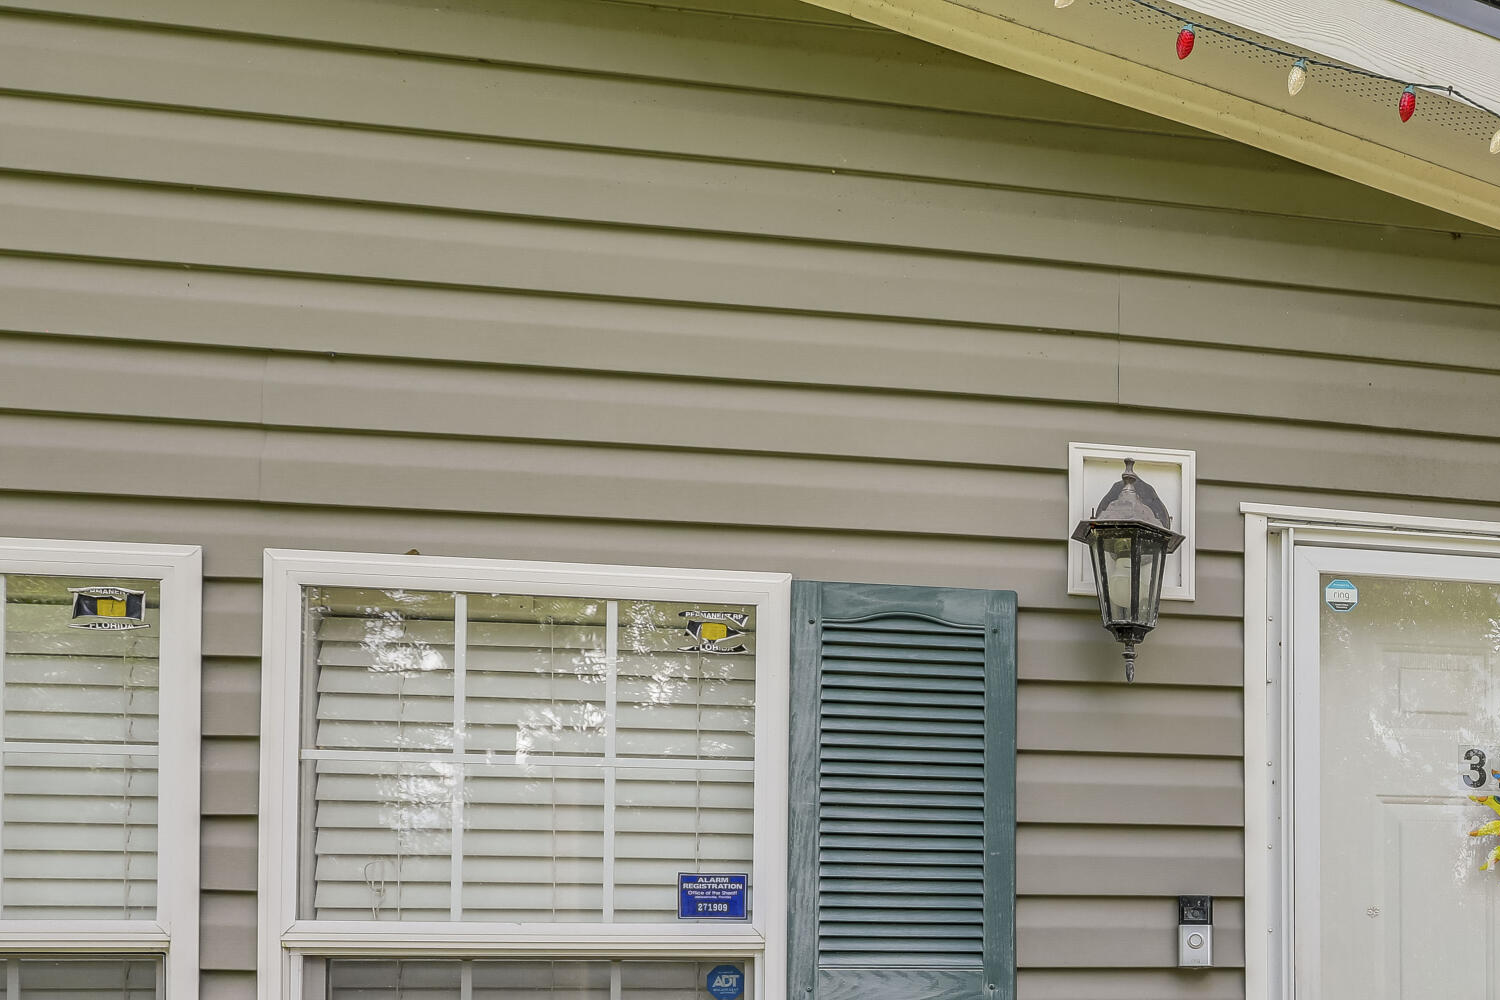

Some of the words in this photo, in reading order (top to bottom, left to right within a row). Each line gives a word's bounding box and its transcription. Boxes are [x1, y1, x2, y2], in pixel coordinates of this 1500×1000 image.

[1333, 591, 1350, 600] ring
[89, 622, 135, 630] FLORIDA
[697, 903, 728, 912] 271909
[711, 974, 740, 988] ADT
